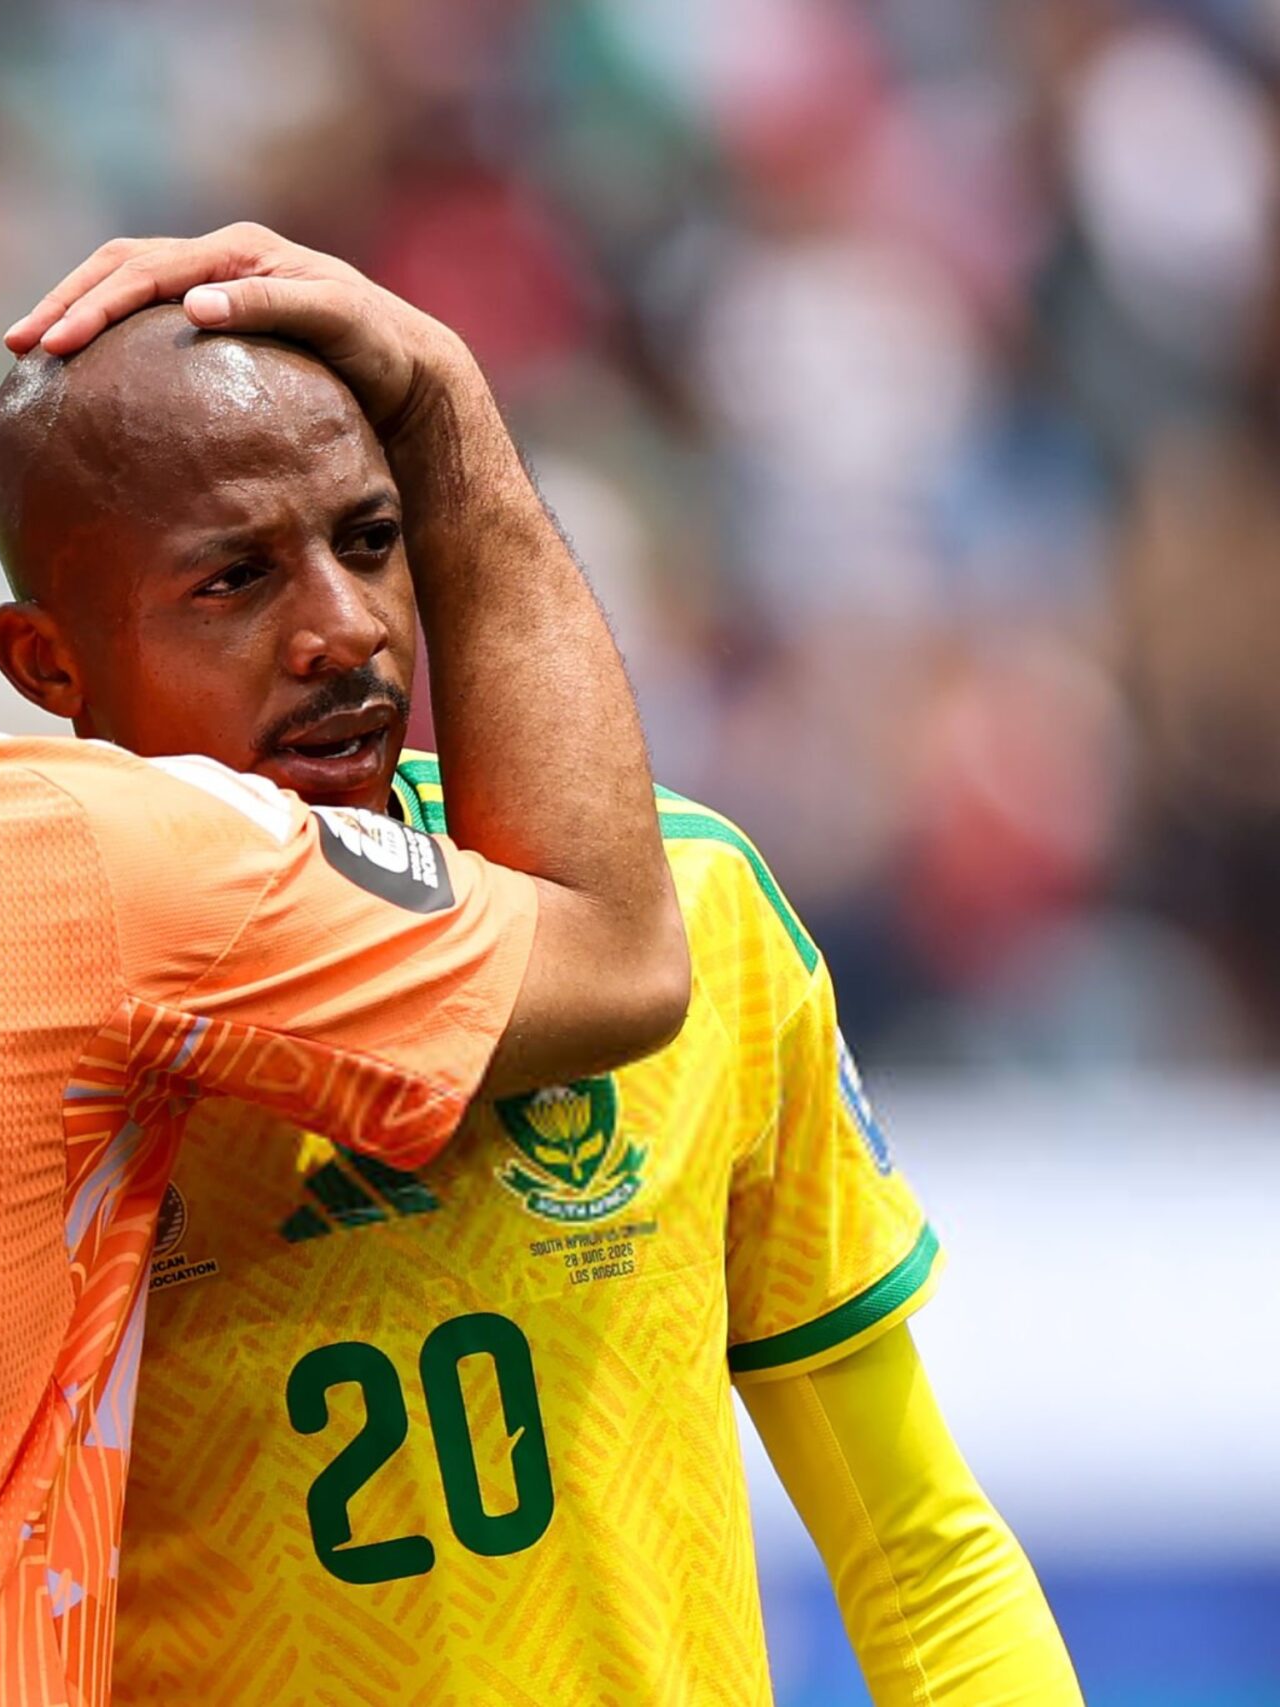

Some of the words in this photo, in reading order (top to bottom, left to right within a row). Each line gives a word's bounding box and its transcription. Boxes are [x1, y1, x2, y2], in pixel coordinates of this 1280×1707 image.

[529, 1238, 563, 1257] SOUTH
[581, 1247, 607, 1265] JUNE
[608, 1242, 634, 1260] 2026
[150, 1261, 216, 1289] OCIATION
[151, 1254, 185, 1274] ICAN
[569, 1268, 590, 1285] LOS
[591, 1260, 635, 1281] ANGELES
[285, 1312, 556, 1587] 20
